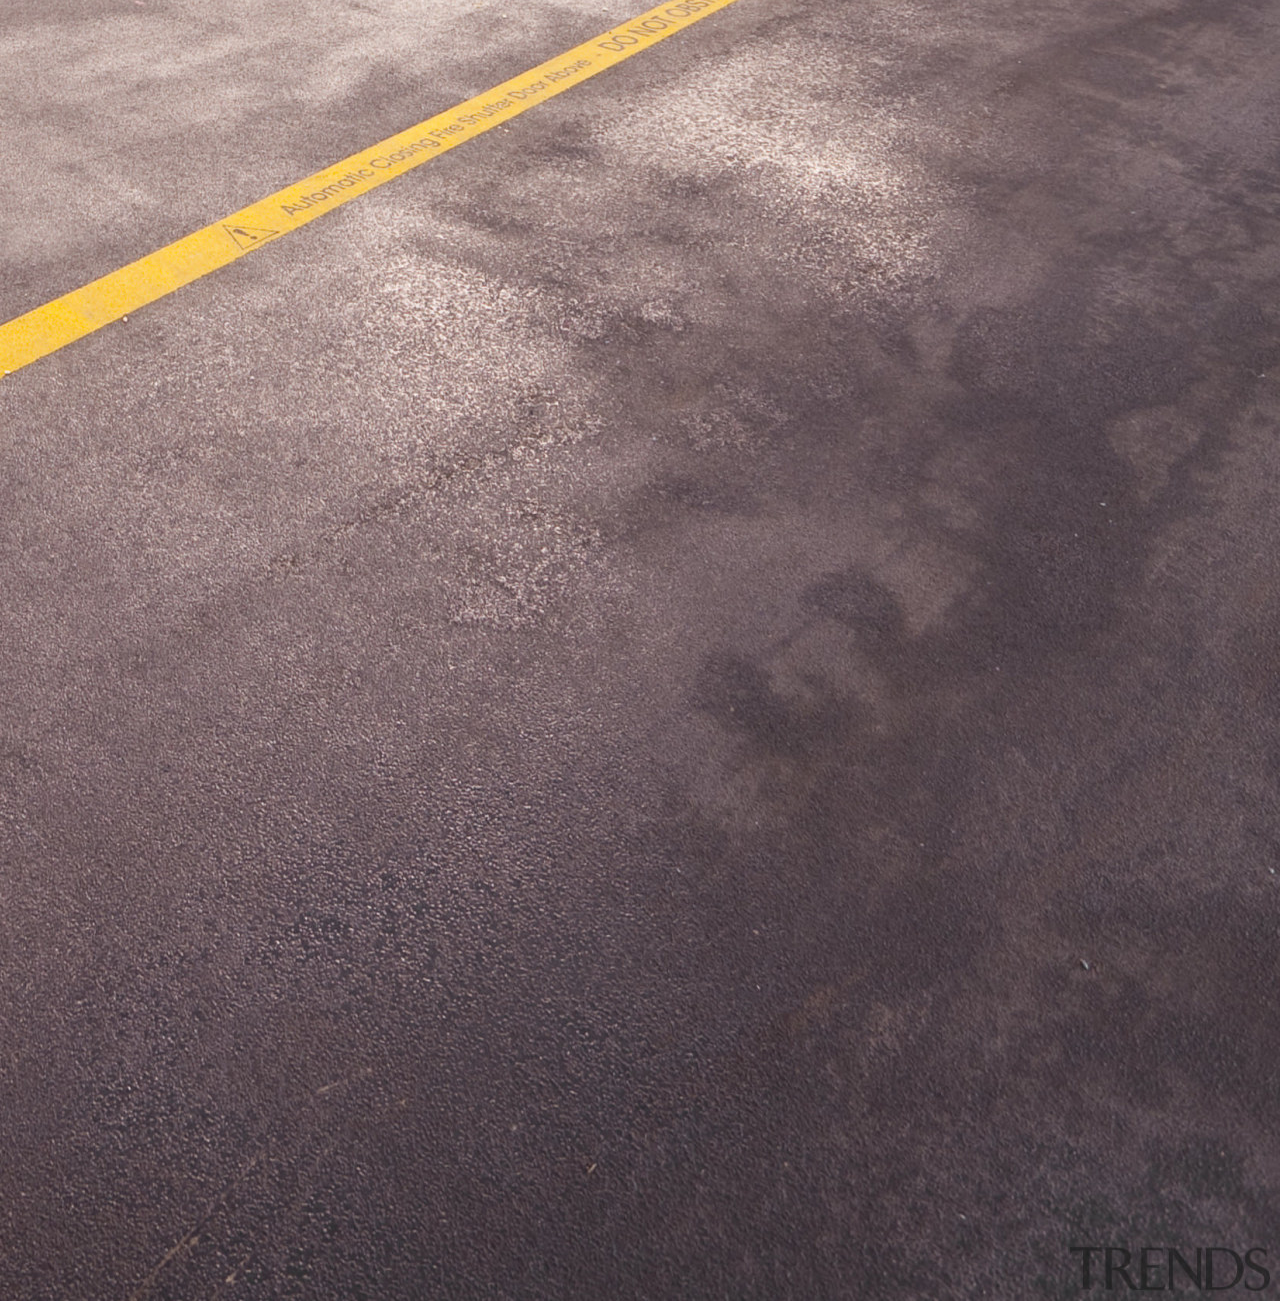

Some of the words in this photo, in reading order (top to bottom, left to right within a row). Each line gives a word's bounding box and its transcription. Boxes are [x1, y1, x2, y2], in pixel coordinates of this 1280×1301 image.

[280, 169, 375, 217] Automatic
[369, 138, 441, 169] Closing
[428, 123, 465, 140] Fire
[457, 98, 515, 125] Shutter
[507, 80, 550, 101] Door
[543, 58, 592, 83] Above
[597, 34, 638, 52] DO
[627, 15, 677, 37] NOT
